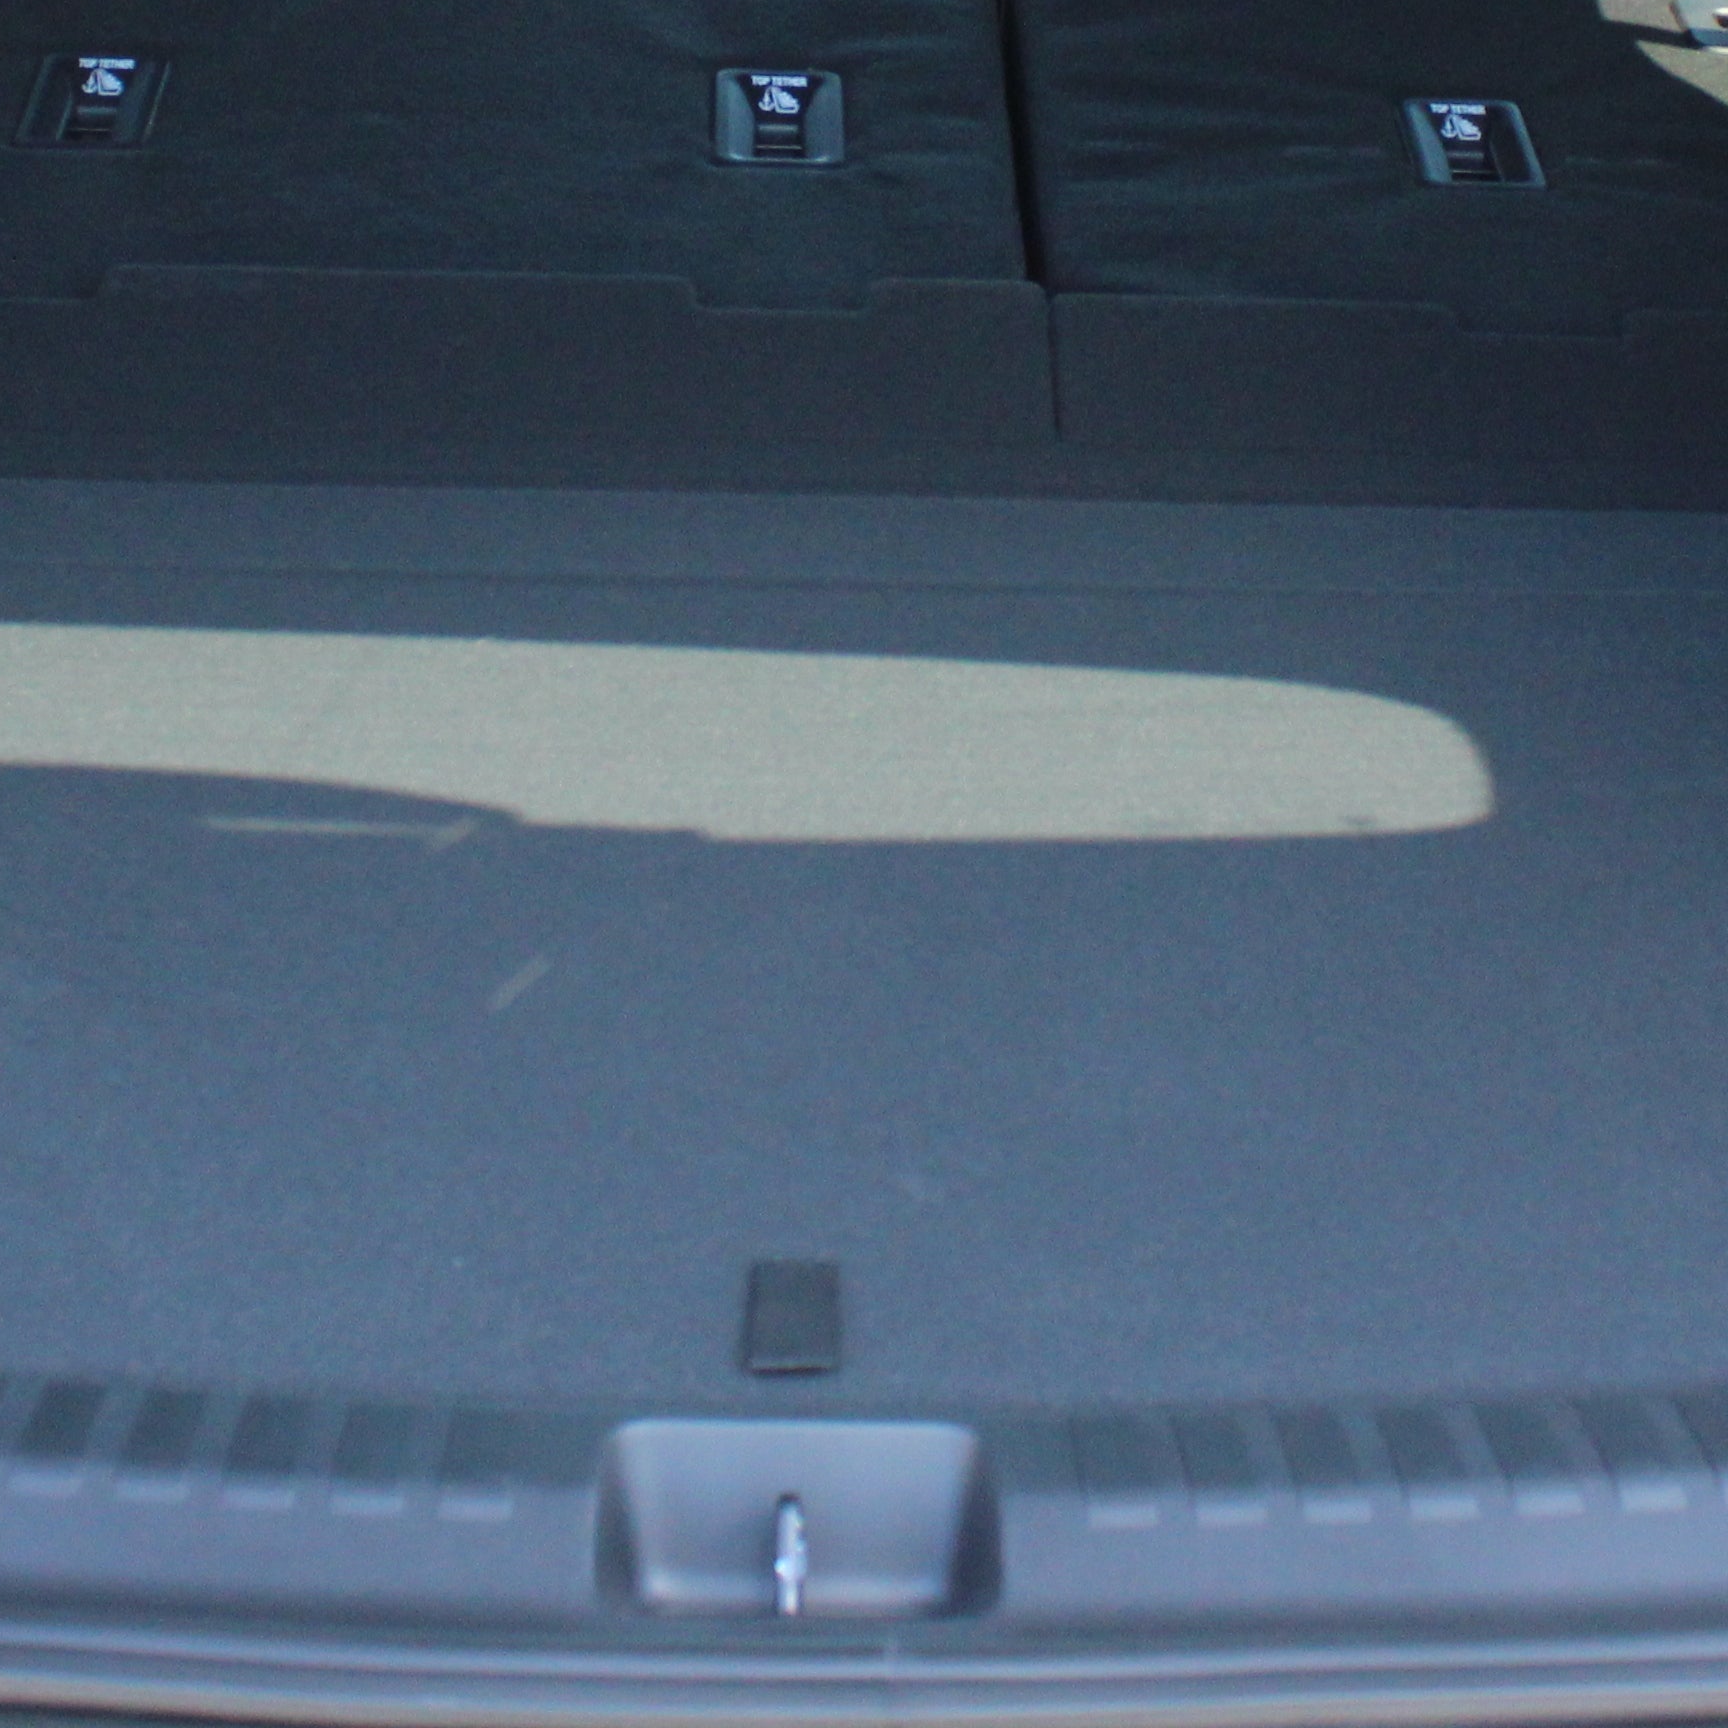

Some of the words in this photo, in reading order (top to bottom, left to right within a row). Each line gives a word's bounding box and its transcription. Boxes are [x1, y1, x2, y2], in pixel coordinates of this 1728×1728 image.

[79, 58, 98, 69] TOP
[99, 58, 136, 70] TETHER
[751, 75, 771, 86] TOP
[771, 76, 808, 87] TETHER
[1429, 103, 1450, 114] TOP
